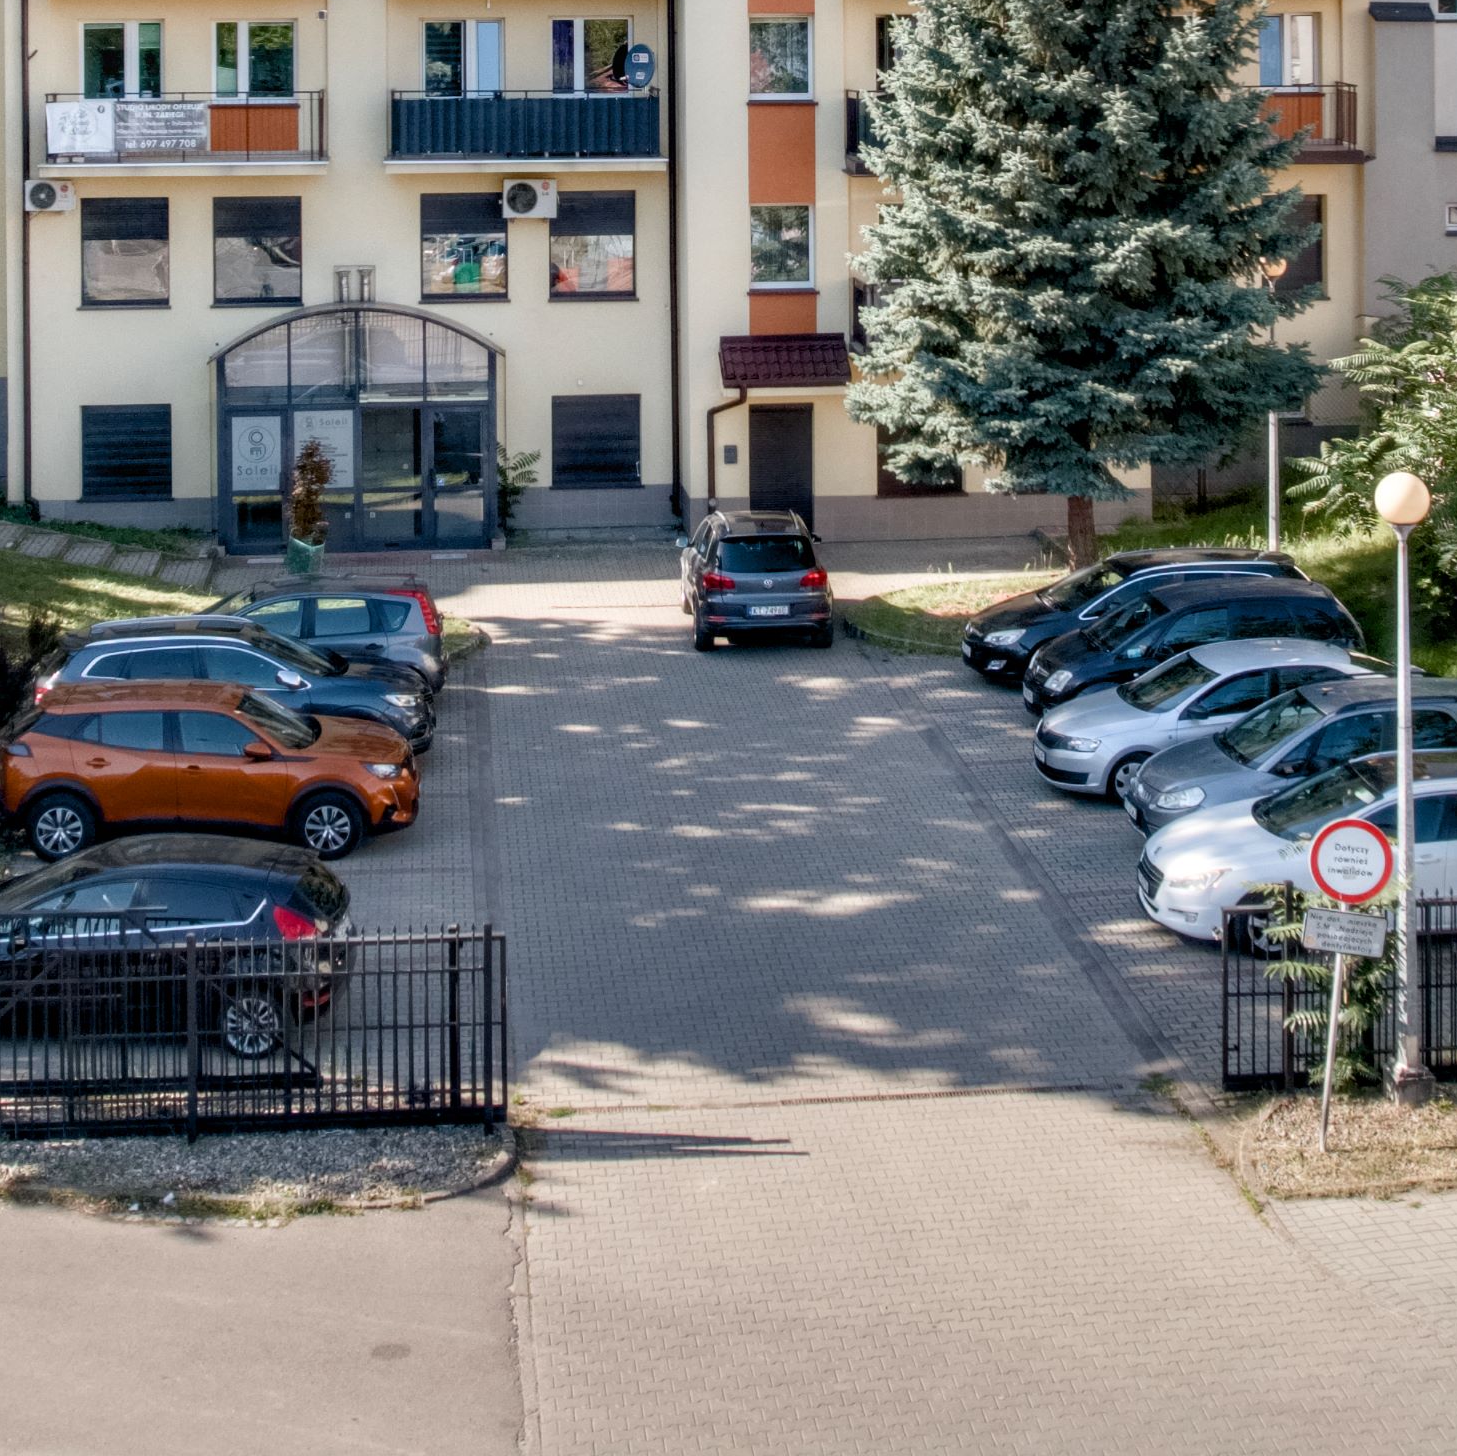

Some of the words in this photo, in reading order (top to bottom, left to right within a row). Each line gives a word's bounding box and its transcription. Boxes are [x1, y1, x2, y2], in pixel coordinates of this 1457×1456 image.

[139, 139, 158, 149] 697
[159, 139, 177, 148] 497
[178, 139, 197, 148] 708
[236, 465, 279, 476] Soleil
[1334, 843, 1369, 855] Dotyczy
